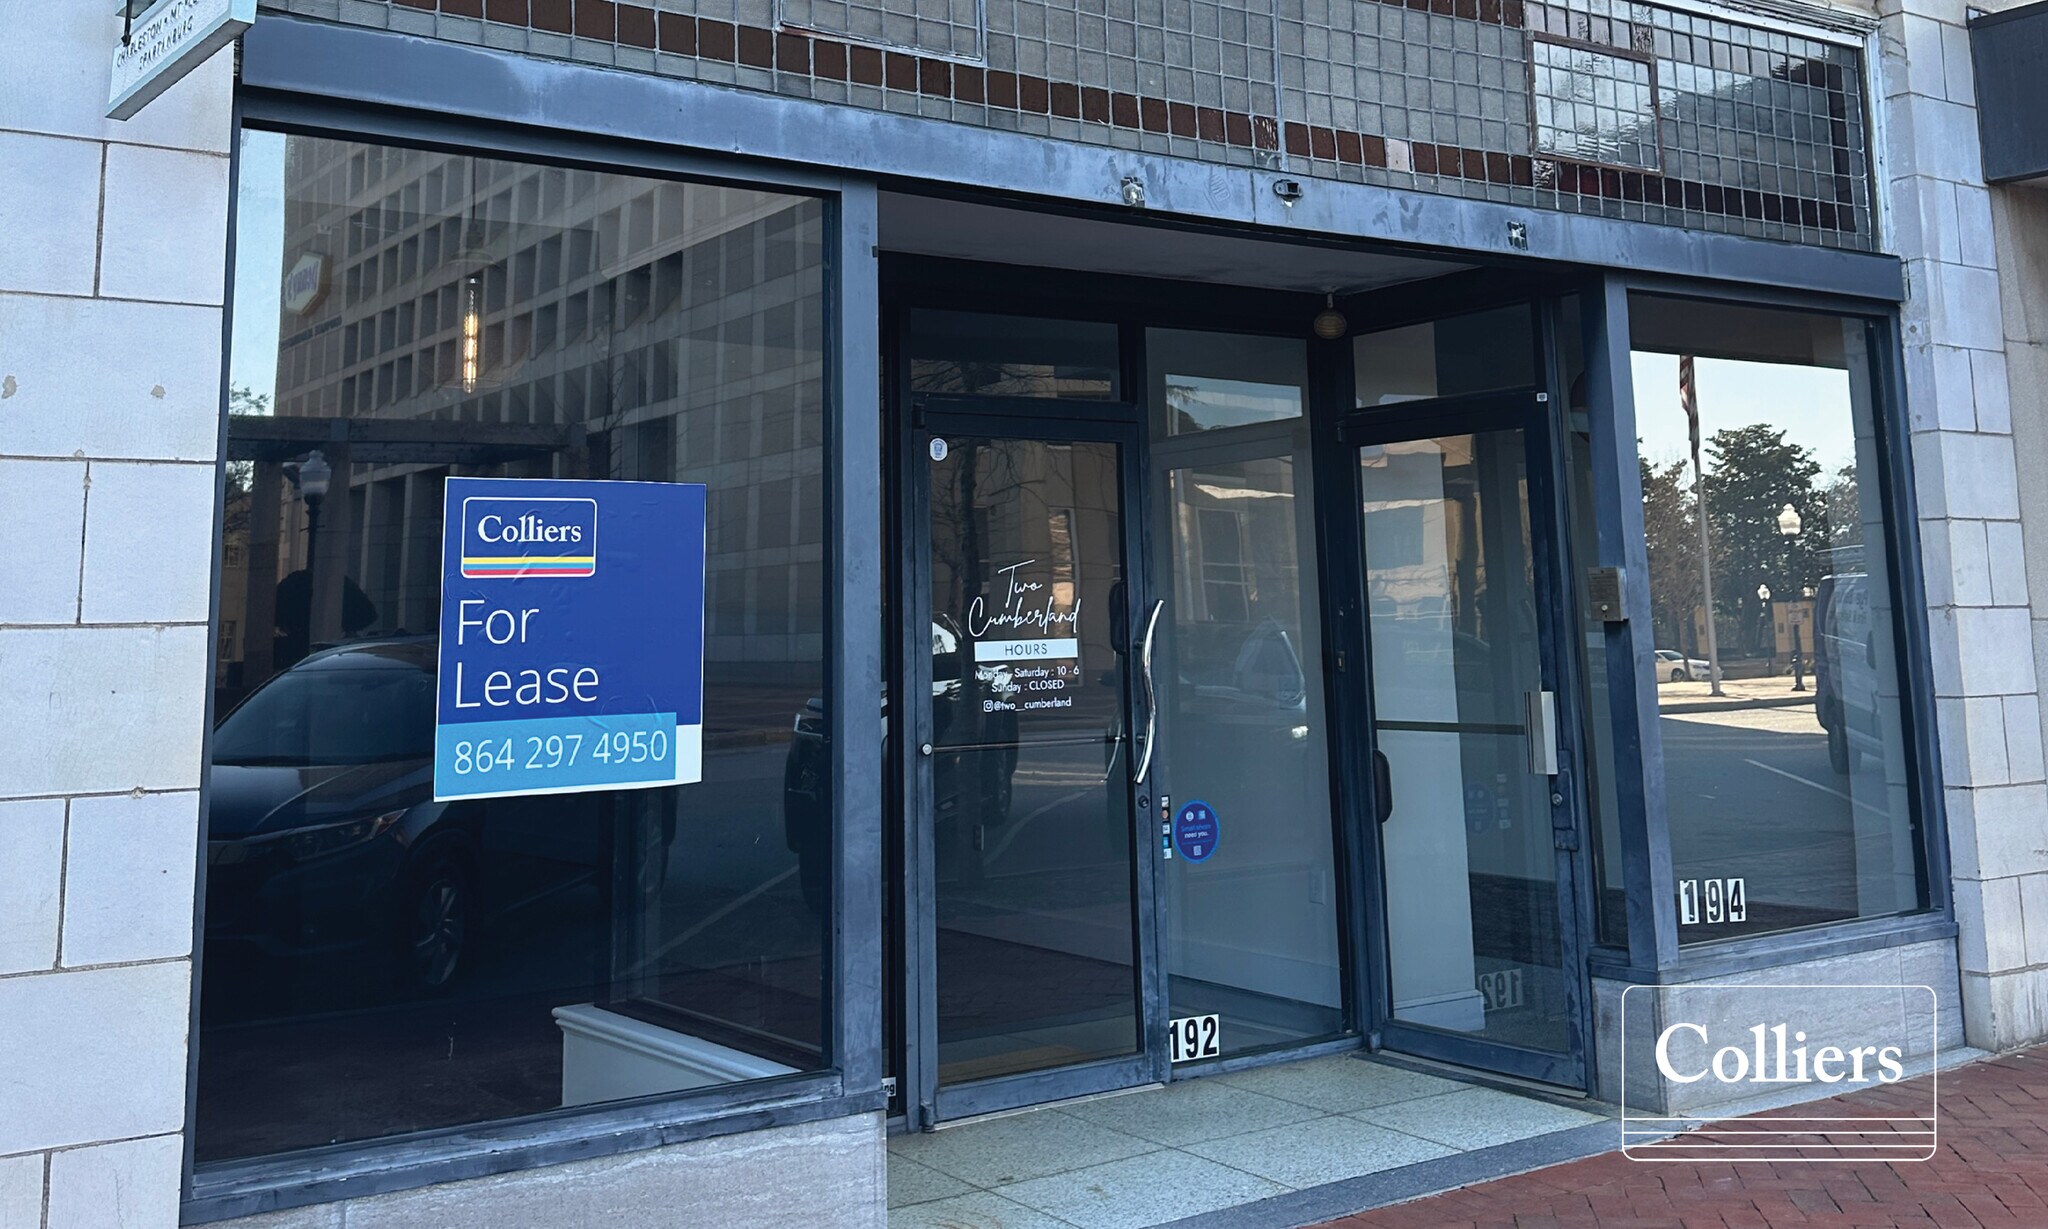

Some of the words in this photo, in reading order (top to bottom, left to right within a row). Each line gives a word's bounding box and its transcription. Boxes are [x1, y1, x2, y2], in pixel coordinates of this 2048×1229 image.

[477, 514, 582, 543] Colliers
[998, 559, 1042, 608] Two
[457, 599, 540, 646] For
[968, 596, 1081, 638] Cumberland
[1004, 643, 1048, 656] HOURS
[455, 661, 600, 709] Lease
[991, 681, 1021, 694] Sunday
[1029, 679, 1064, 691] CLOSED
[1014, 666, 1049, 679] Saturday
[1056, 666, 1067, 676] 10
[1073, 665, 1080, 675] 6
[453, 738, 515, 775] 864
[525, 734, 583, 769] 297
[592, 729, 668, 764] 4950
[1684, 880, 1744, 922] 194
[1169, 1016, 1218, 1061] 192
